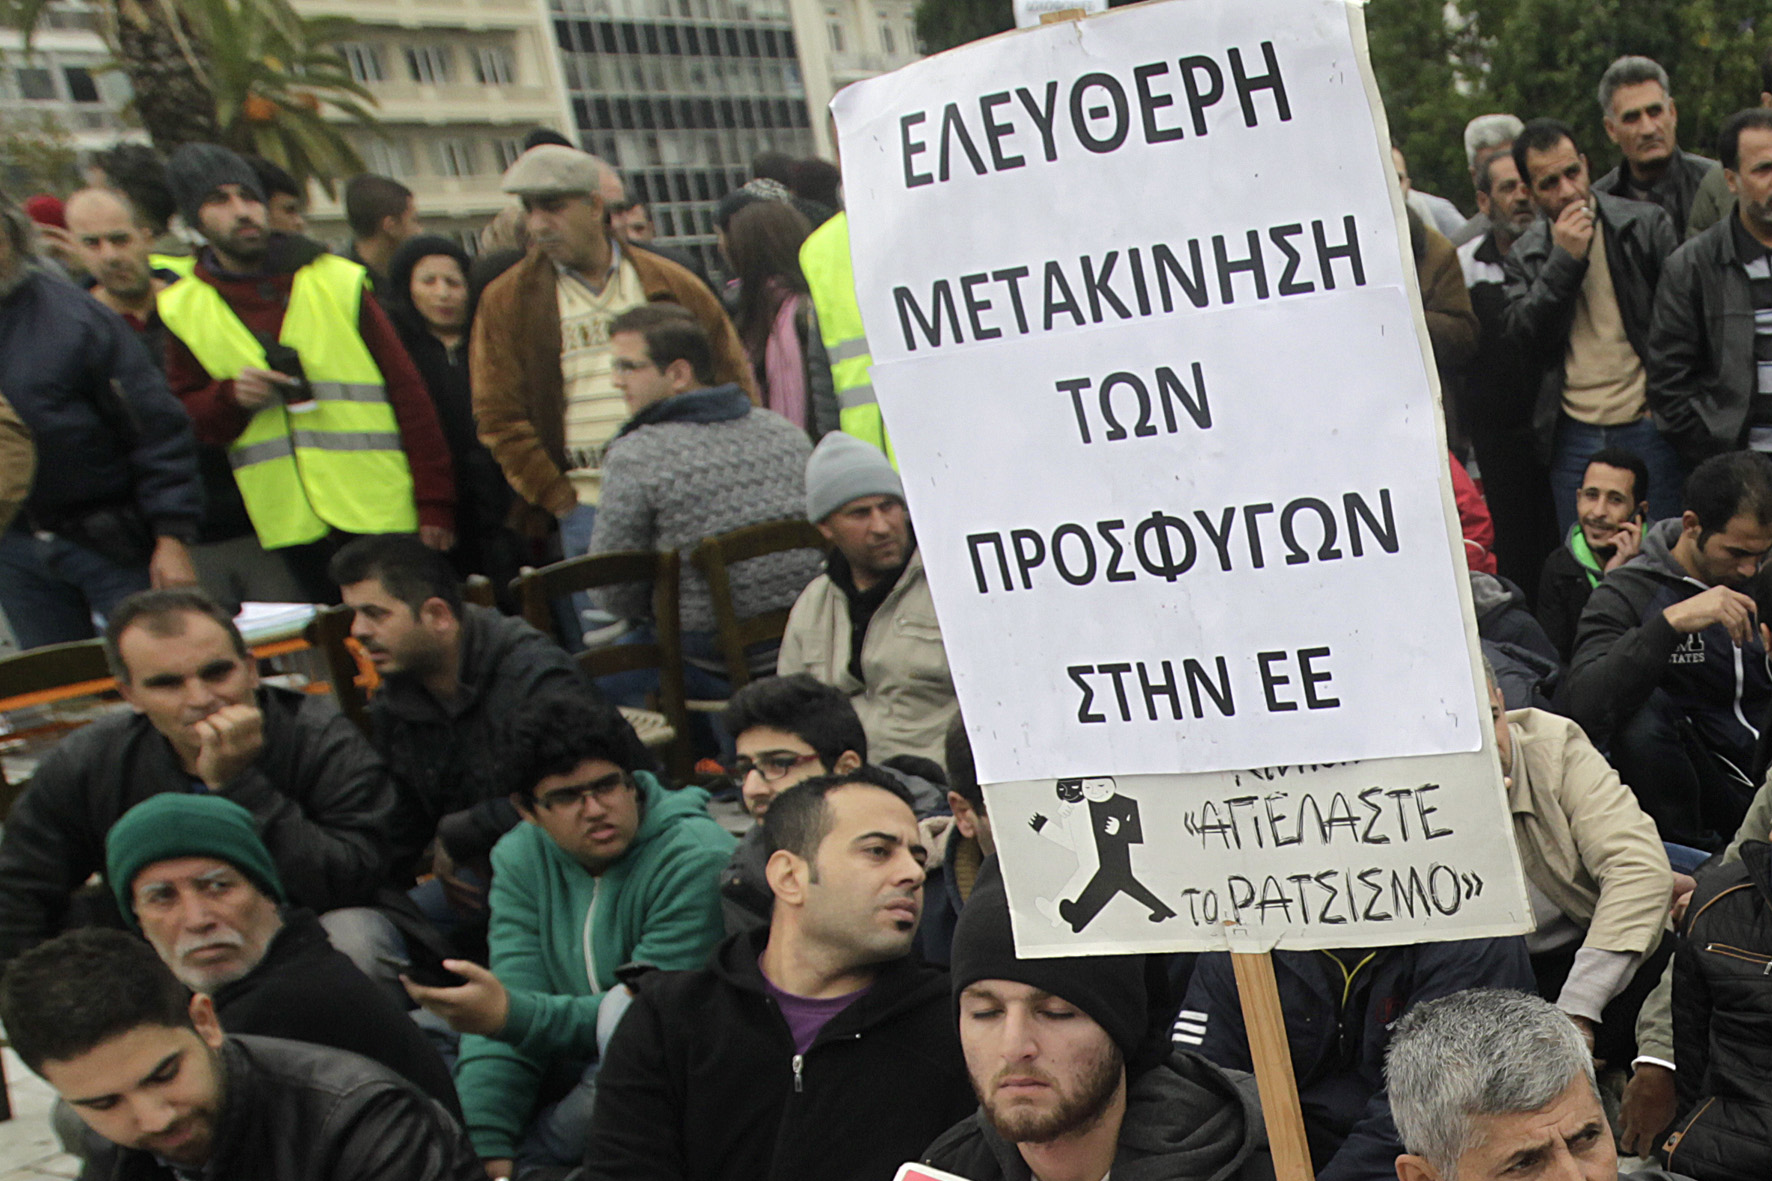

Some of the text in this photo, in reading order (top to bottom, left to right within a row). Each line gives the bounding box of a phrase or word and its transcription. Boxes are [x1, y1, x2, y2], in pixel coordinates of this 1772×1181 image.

[900, 41, 1292, 188] ΕΛΕΥΘΕΡΗ
[893, 215, 1366, 351] ΜΕΤΑΚΙΝΗΣΗ
[1055, 362, 1212, 444] ΤΩΝ
[966, 488, 1399, 594] ΠΡΟΣΦΥΓΩΝ
[1067, 647, 1340, 723] ΣΤΗΝ ΕΕ
[1668, 652, 1705, 664] TATES
